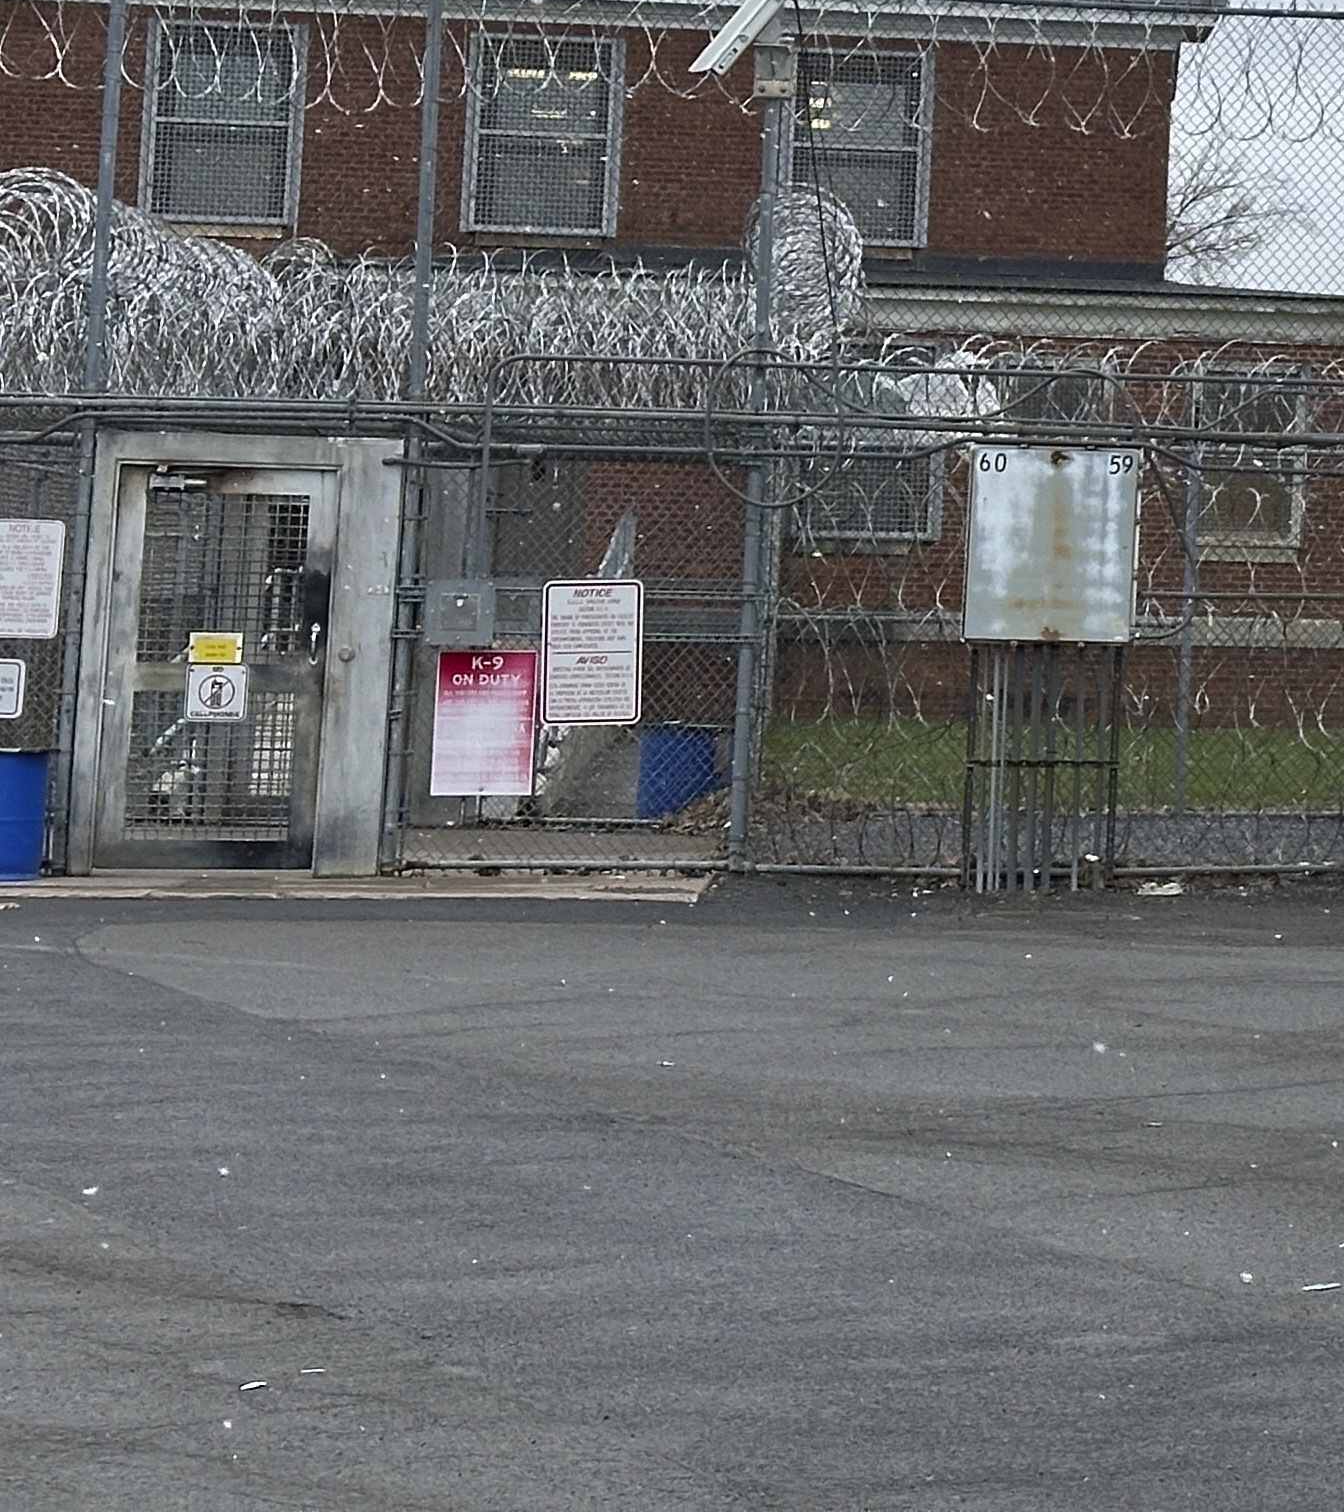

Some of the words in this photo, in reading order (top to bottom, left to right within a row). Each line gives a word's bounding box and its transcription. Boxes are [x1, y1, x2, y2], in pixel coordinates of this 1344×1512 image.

[979, 452, 1007, 473] 60
[1108, 454, 1134, 475] 59
[573, 588, 614, 598] NOTICE
[471, 655, 504, 670] K-9
[575, 655, 608, 665] AVISO
[452, 673, 474, 686] ON
[478, 673, 521, 686] DUTY
